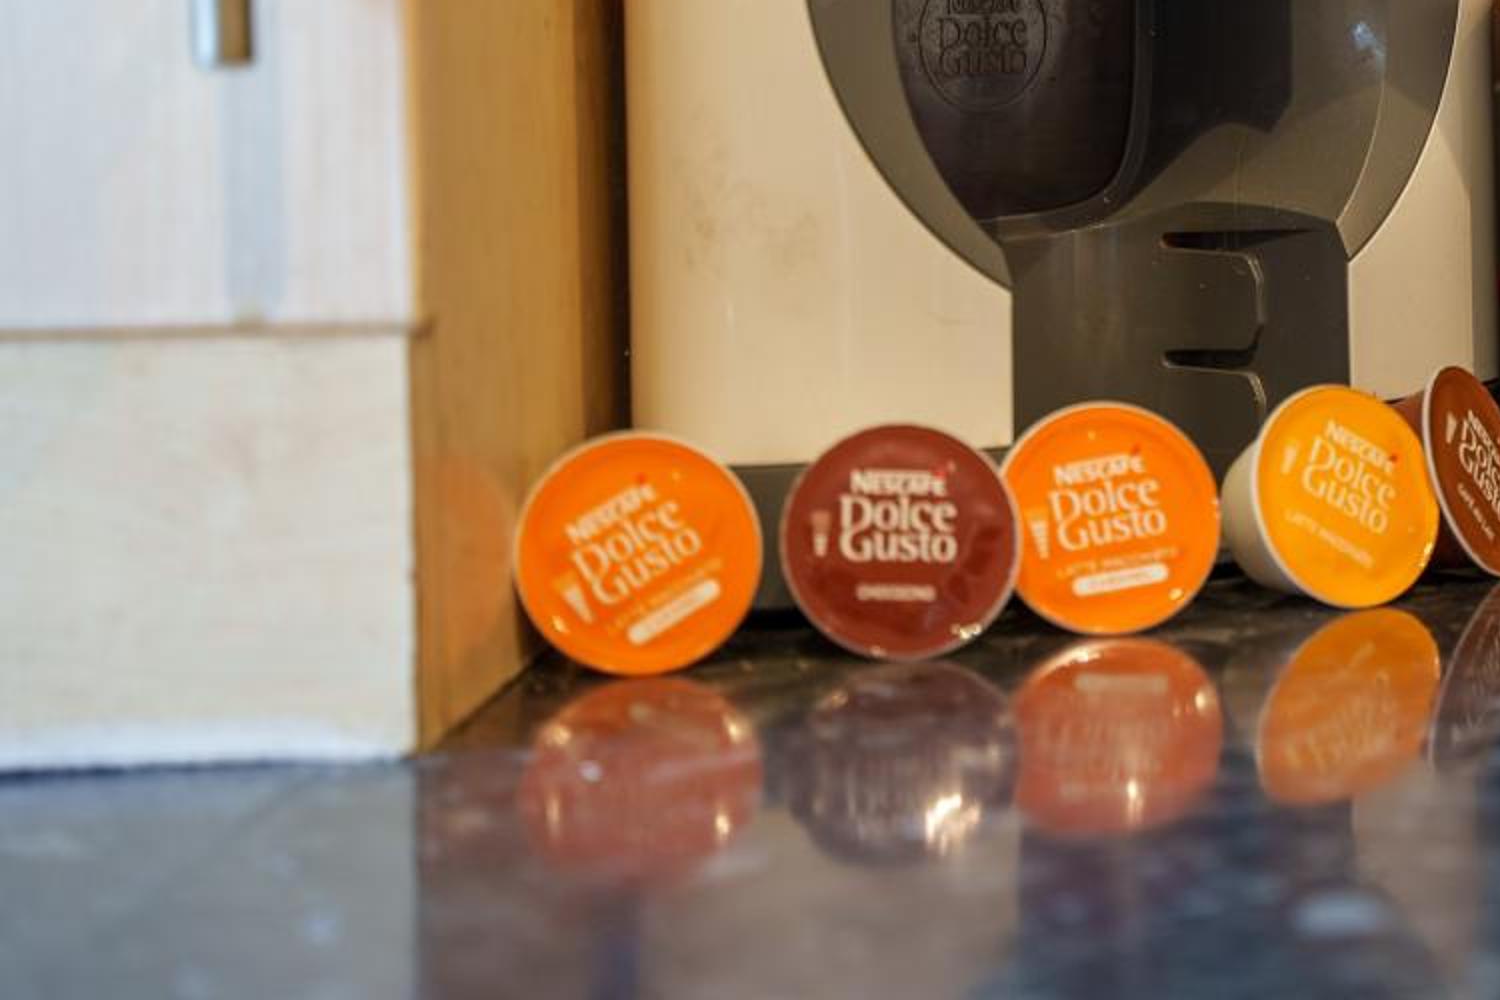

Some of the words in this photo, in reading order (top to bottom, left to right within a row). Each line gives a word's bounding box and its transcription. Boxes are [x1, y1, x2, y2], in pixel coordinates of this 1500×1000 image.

[1048, 478, 1161, 524] Dolce
[1302, 464, 1389, 535] Gusto
[1309, 434, 1397, 511] Dolce
[571, 500, 680, 582] Dolce
[839, 492, 958, 533] Dolce
[1056, 508, 1168, 552] Gusto
[590, 526, 703, 605] Gusto
[839, 529, 959, 563] Gusto
